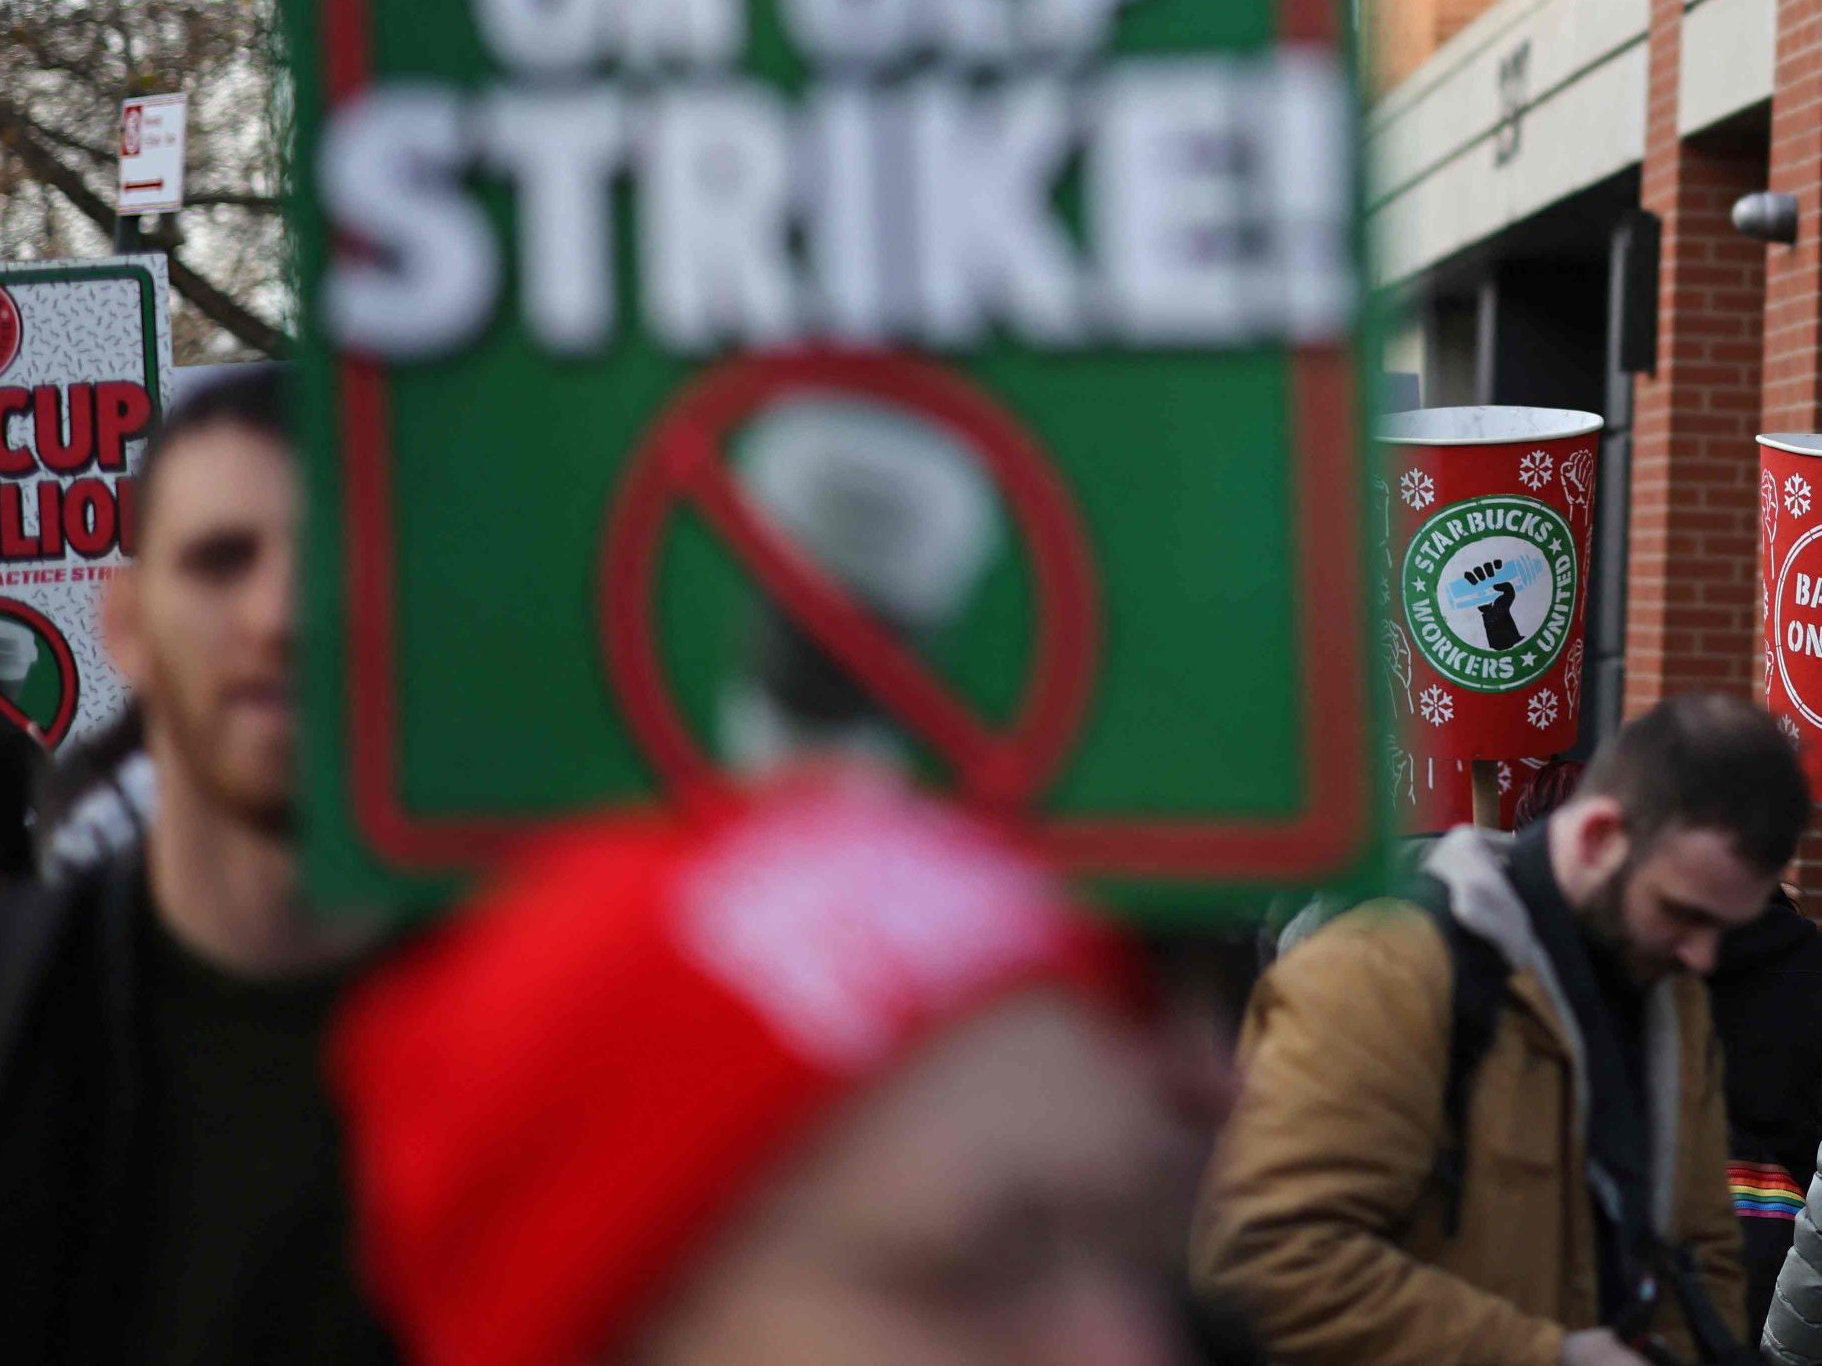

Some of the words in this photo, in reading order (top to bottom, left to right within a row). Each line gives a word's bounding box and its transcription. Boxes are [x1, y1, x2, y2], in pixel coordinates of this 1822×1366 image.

[318, 47, 1357, 361] STRIKE!
[0, 380, 152, 477] CUP
[1414, 508, 1553, 574] STARBUCKS
[1412, 597, 1515, 680] WORKERS
[1536, 554, 1572, 652] UNITED
